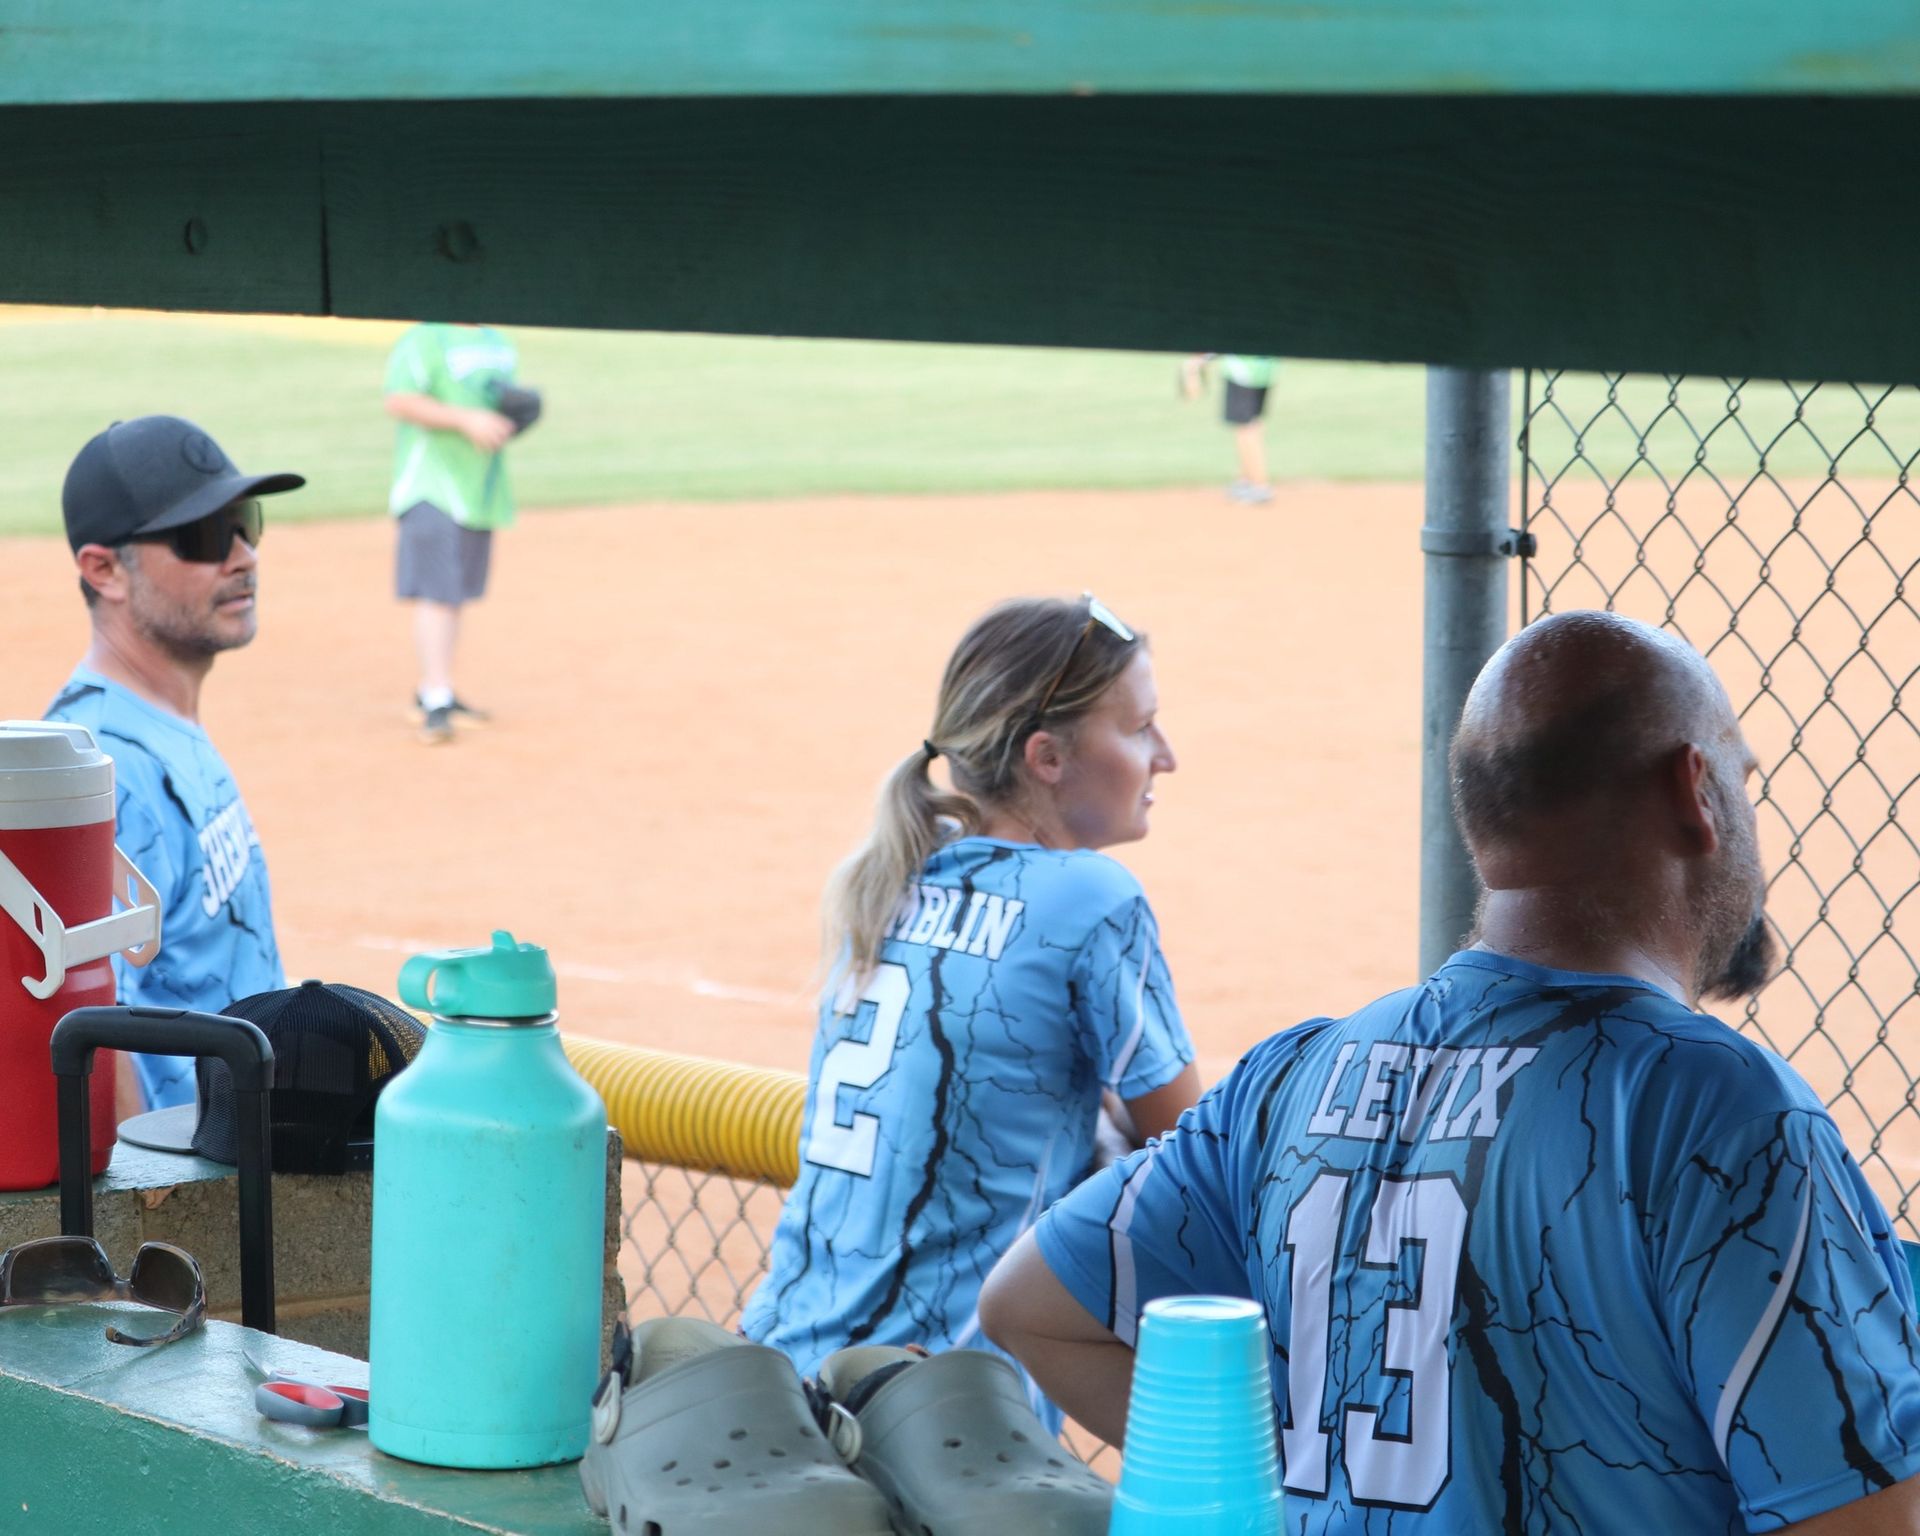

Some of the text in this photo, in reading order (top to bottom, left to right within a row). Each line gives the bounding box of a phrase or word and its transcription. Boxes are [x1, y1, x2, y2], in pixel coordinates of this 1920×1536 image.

[883, 883, 1026, 962] MBLIN
[805, 960, 913, 1180] 2
[1306, 1040, 1542, 1144] LEVIX
[1282, 1167, 1470, 1513] 13
